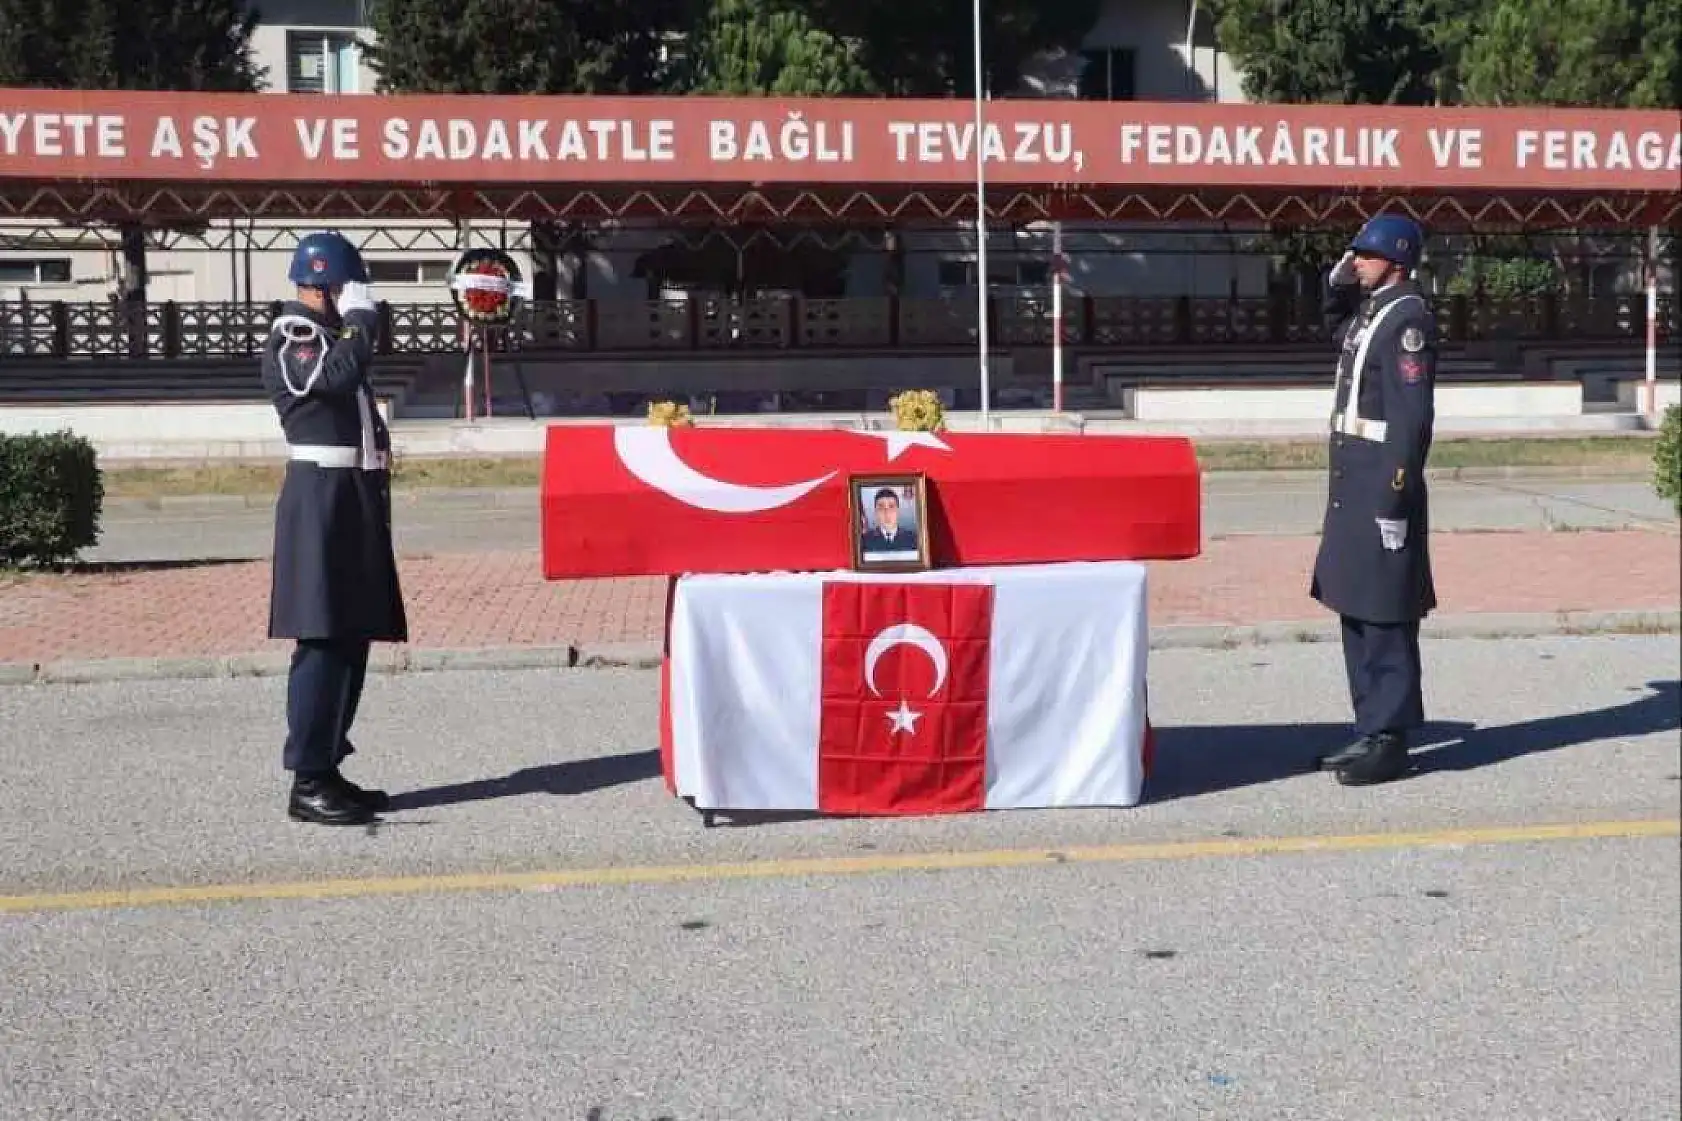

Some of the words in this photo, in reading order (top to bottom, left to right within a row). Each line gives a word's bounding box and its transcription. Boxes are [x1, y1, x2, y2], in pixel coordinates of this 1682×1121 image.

[0, 113, 126, 157] YETE
[150, 115, 259, 169] AŞK
[293, 118, 359, 160] VE
[381, 118, 675, 161] SADAKATLE
[709, 110, 854, 162] BAĞLI
[887, 122, 1083, 172] TEVAZU,
[1120, 119, 1401, 168] FEDAKÂRLIK
[1426, 129, 1482, 168] VE
